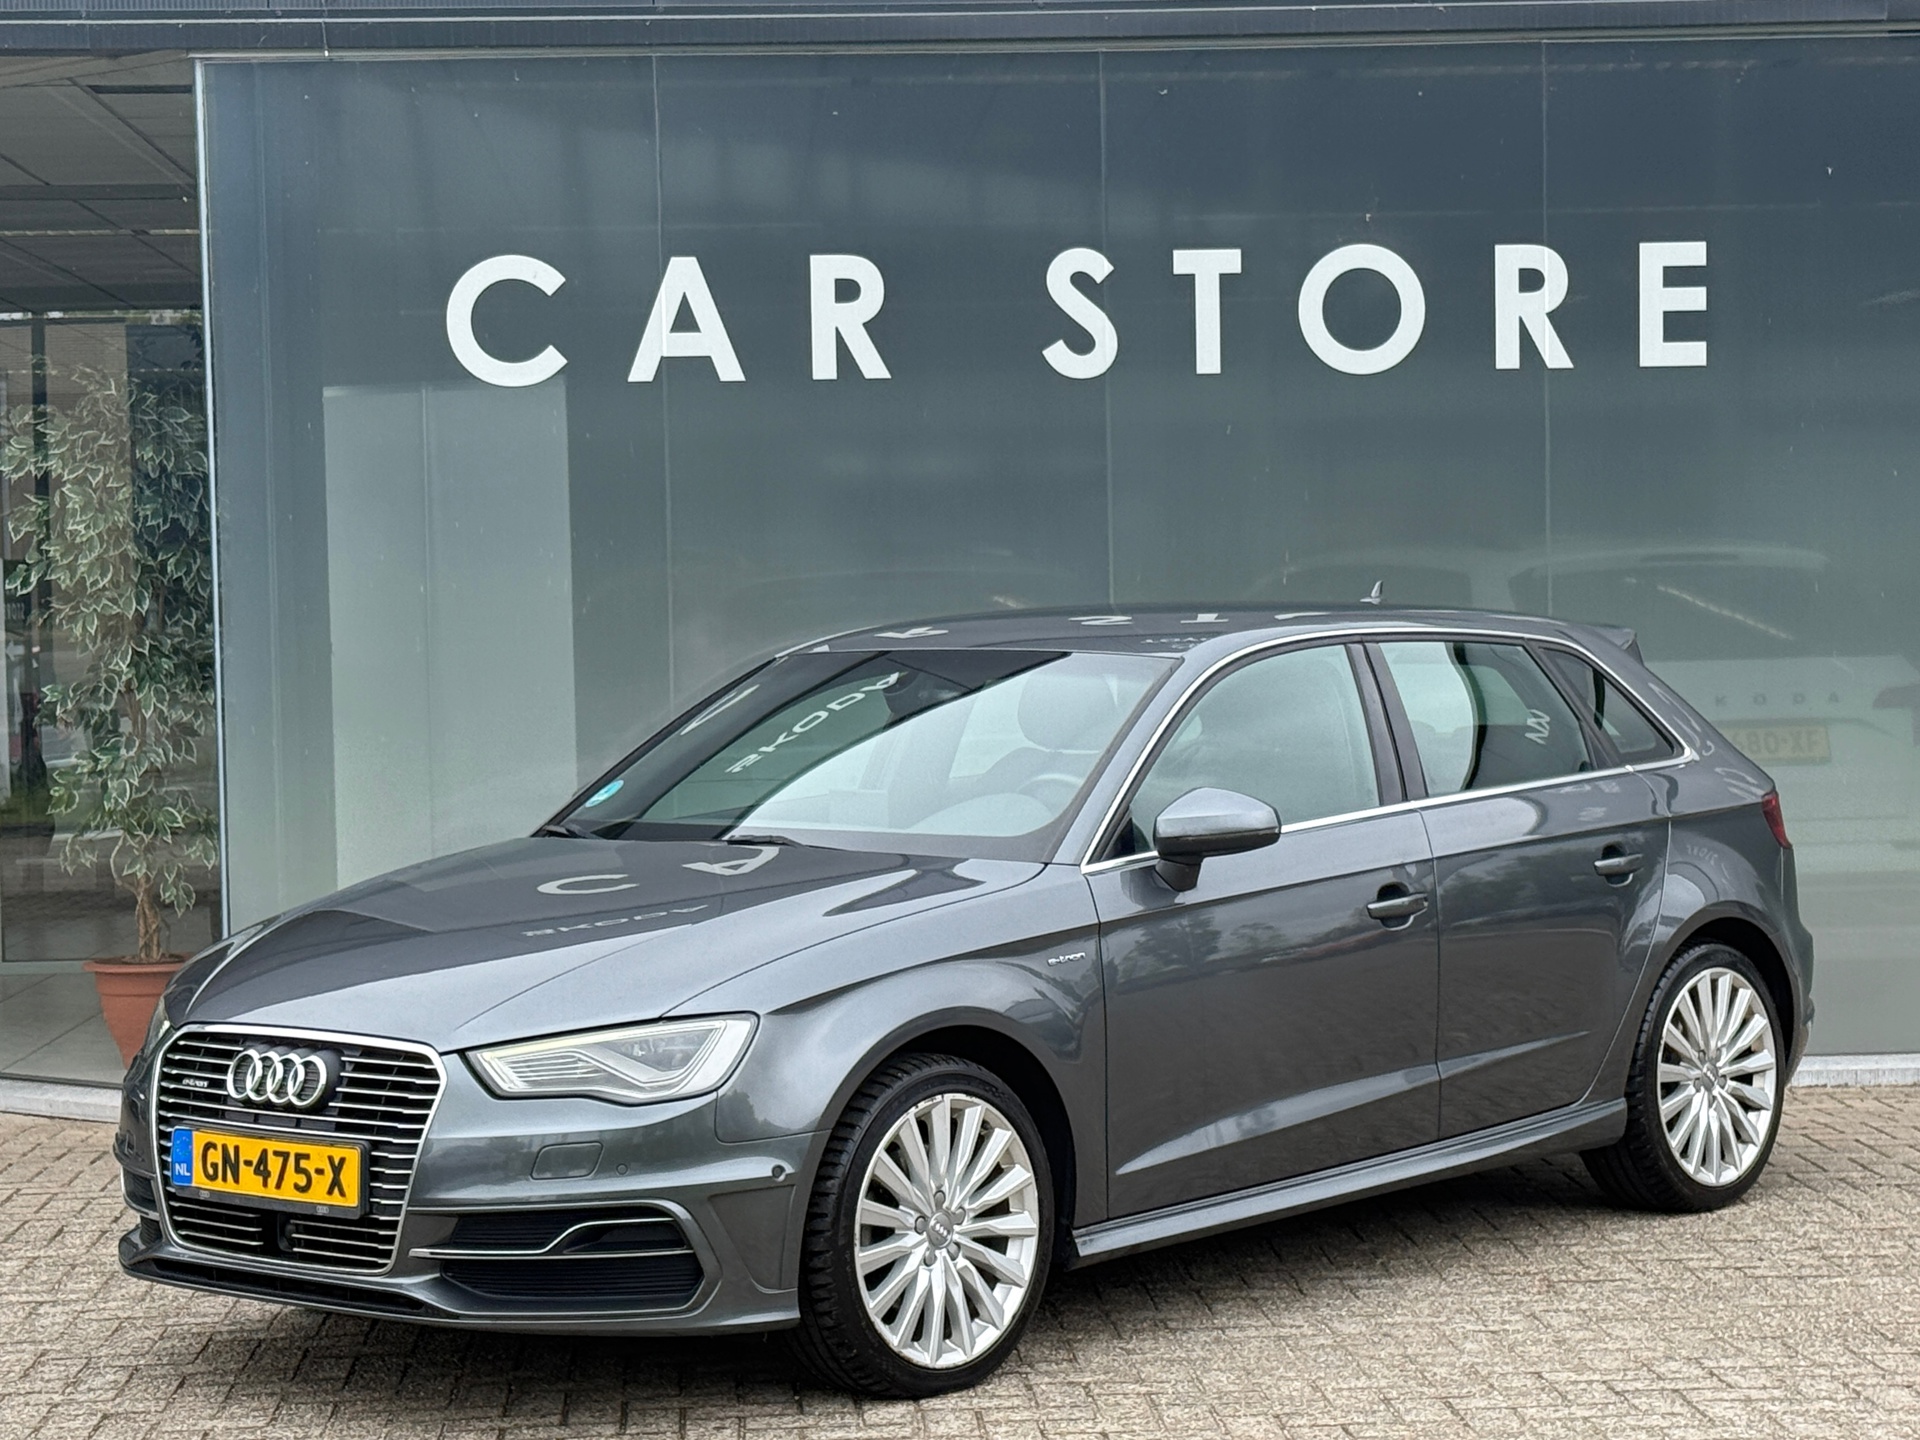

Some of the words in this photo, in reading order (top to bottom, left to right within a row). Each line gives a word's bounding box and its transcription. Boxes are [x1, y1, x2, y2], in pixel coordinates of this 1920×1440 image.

[446, 254, 892, 387] CAR
[1042, 241, 1707, 381] STORE
[175, 1163, 191, 1177] NL
[201, 1140, 347, 1198] GN-475-X
